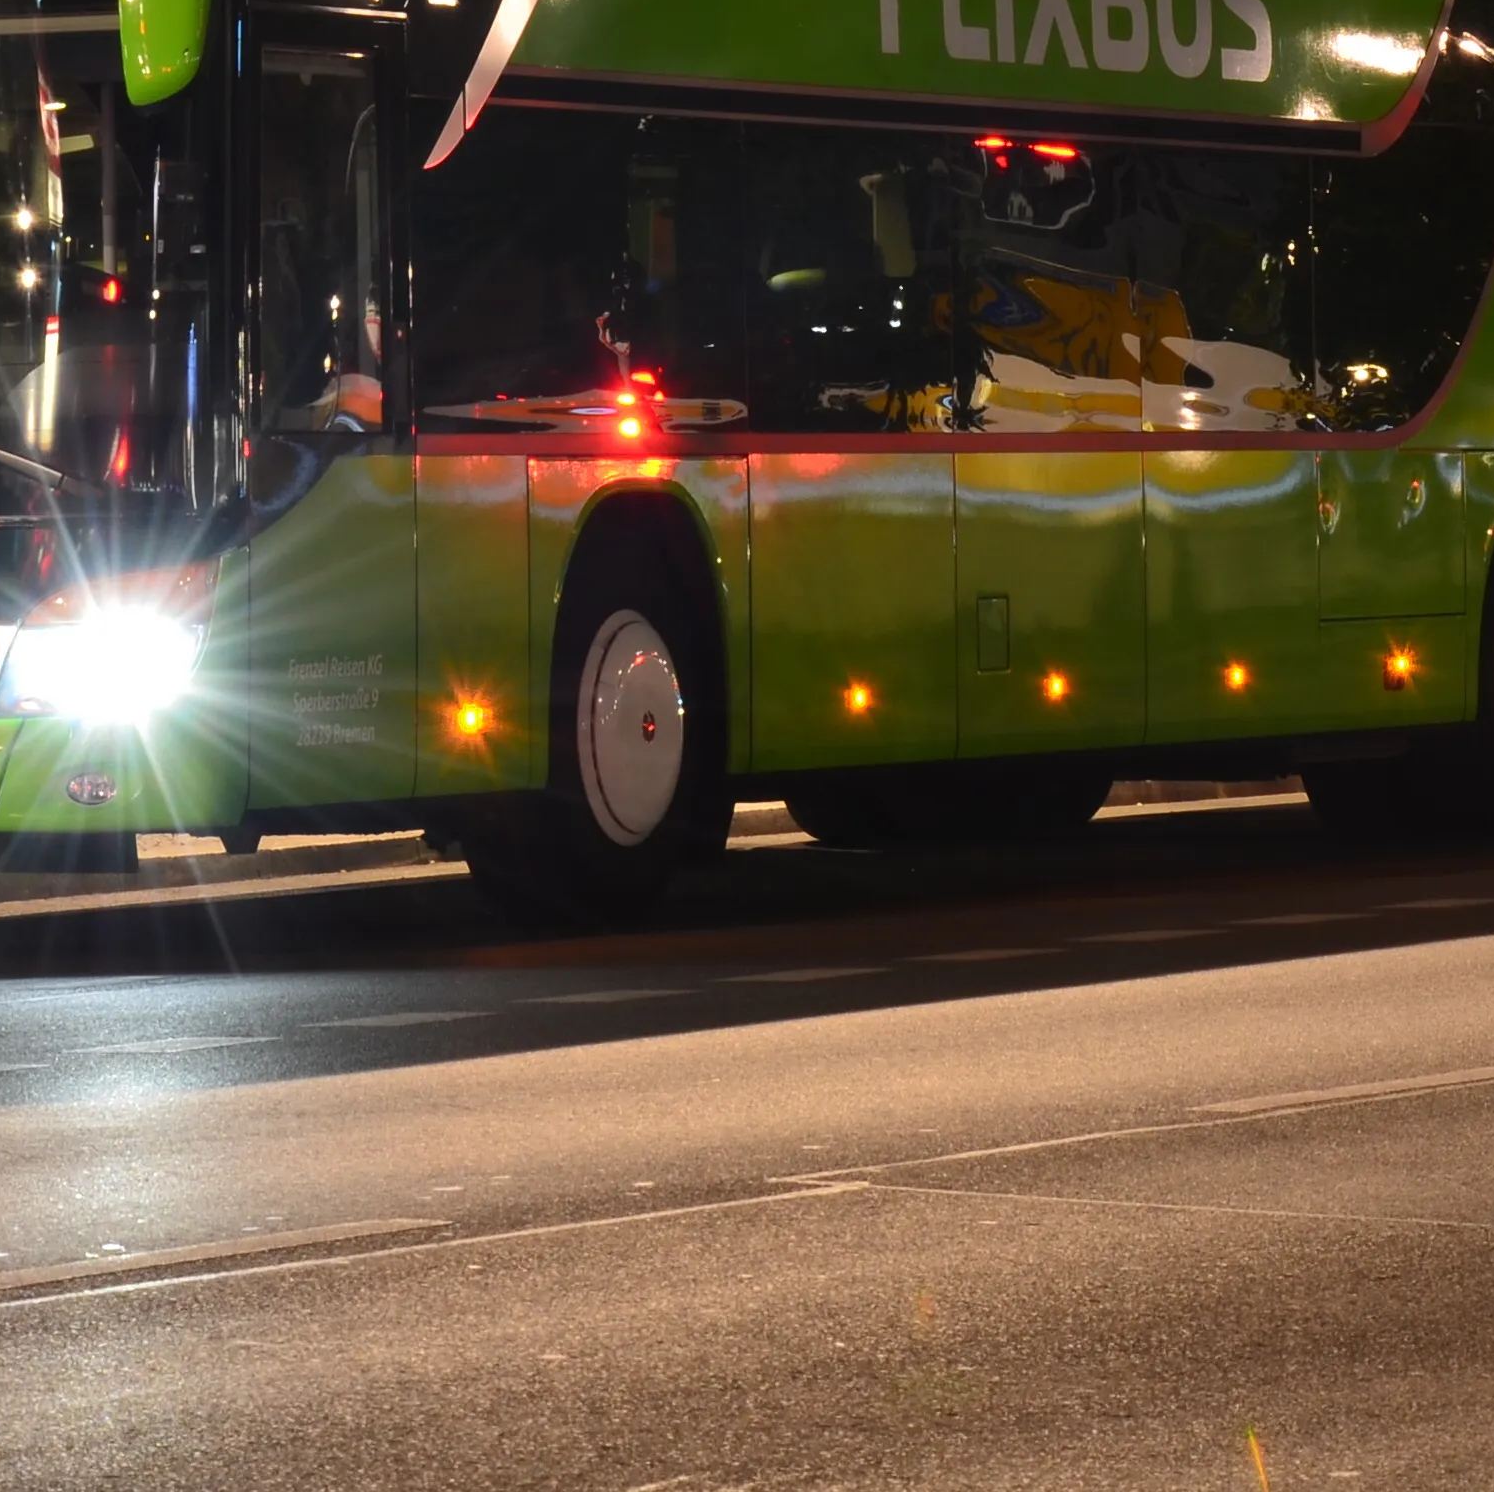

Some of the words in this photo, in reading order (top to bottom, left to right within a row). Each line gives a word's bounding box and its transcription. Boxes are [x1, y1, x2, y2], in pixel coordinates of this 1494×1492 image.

[288, 655, 328, 680] Frenzel
[329, 655, 365, 677] Reisen
[367, 654, 383, 676] KG
[293, 687, 370, 718] Sperberstraße
[371, 688, 379, 708] 9
[333, 723, 375, 744] Bremen
